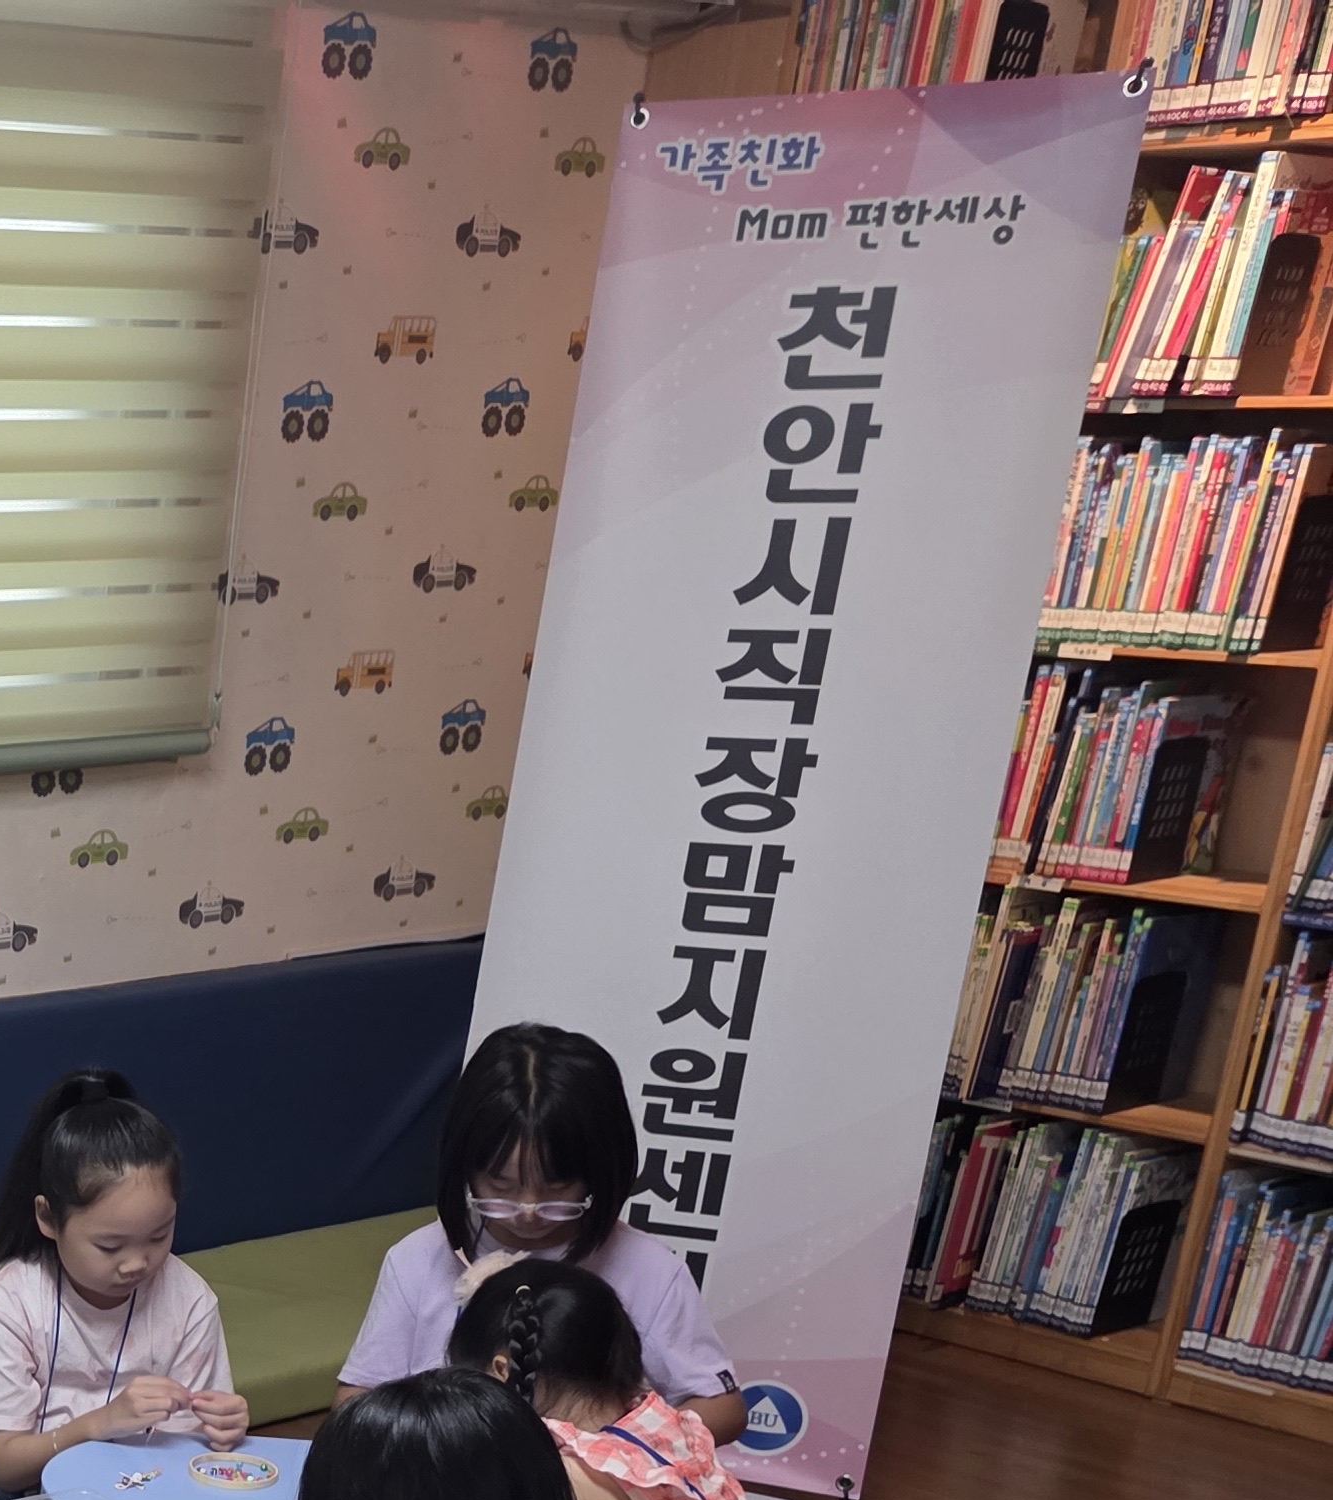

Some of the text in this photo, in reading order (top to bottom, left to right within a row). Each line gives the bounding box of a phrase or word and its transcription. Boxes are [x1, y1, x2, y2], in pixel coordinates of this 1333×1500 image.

[656, 136, 821, 193] 가족친화
[735, 193, 1026, 249] Mom 편한세상
[749, 1410, 779, 1428] BU
